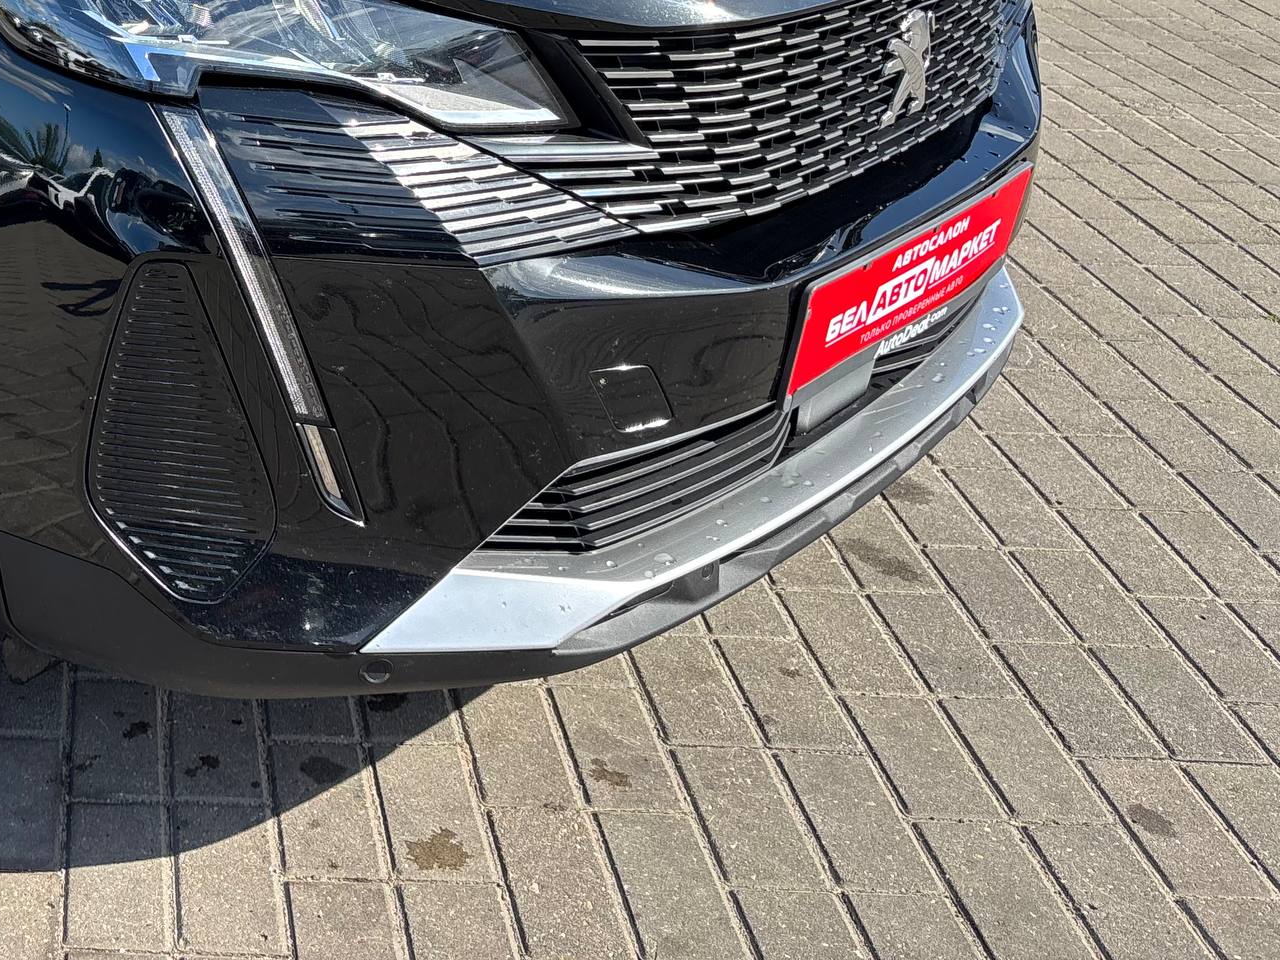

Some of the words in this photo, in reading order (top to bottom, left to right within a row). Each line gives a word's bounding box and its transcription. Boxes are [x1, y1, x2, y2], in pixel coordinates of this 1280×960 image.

[892, 216, 970, 272] АВТОСАЛОН
[860, 319, 891, 344] ТОЛЬКО
[945, 275, 964, 294] АВТО
